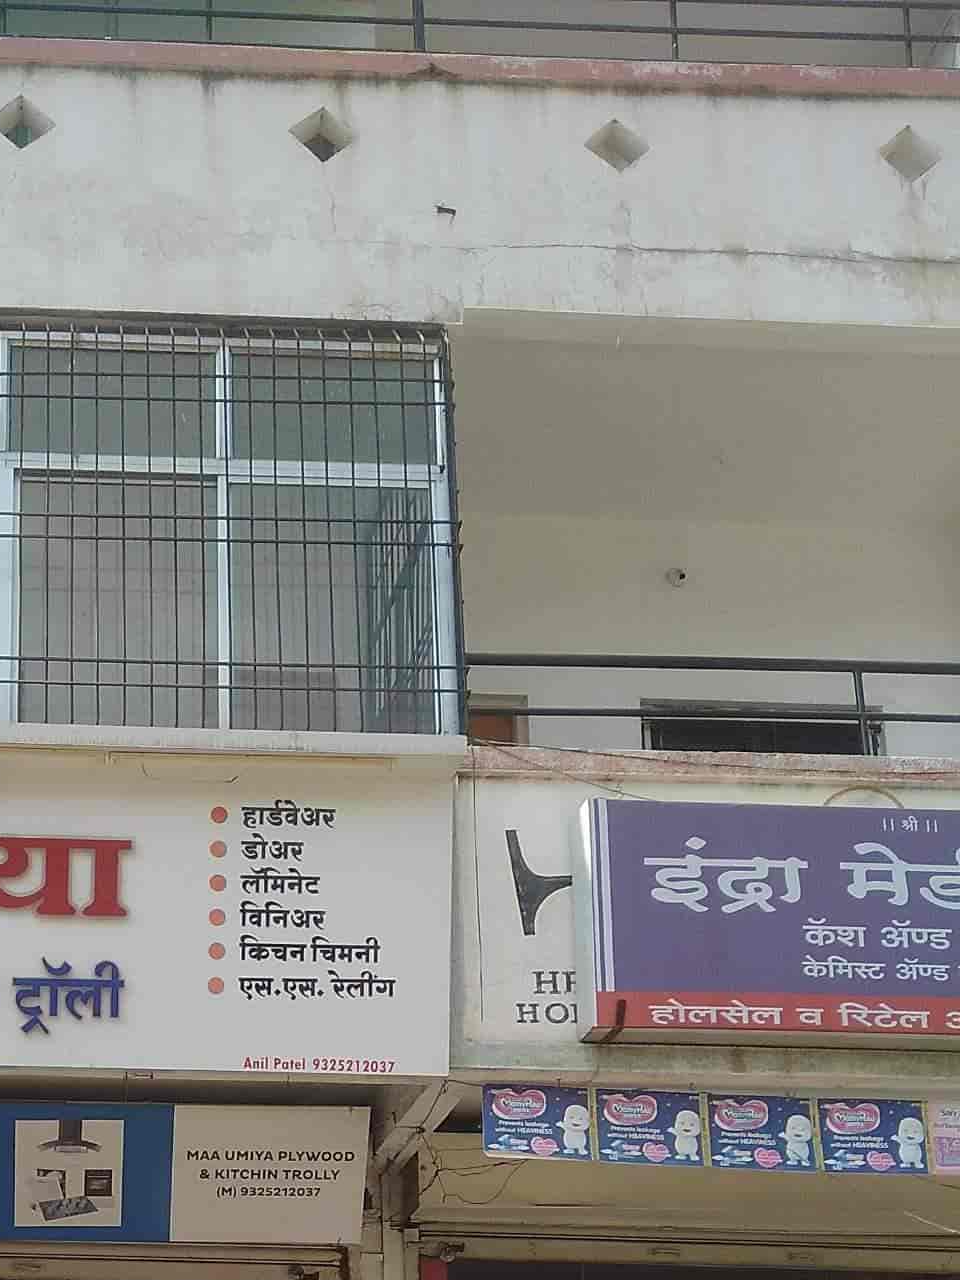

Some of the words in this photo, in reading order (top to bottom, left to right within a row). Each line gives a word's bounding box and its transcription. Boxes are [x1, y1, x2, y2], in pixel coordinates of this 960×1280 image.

[240, 800, 336, 828] हार्डवेअर
[901, 816, 918, 832] श्री
[240, 833, 304, 861] डोअर
[643, 836, 809, 912] इंद्रा
[240, 901, 326, 929] विनिअर
[802, 917, 867, 947] कॅश
[240, 935, 307, 962] किचन
[311, 936, 380, 964] चिमनी
[801, 955, 887, 979] केमिस्ट
[12, 957, 125, 1034] ट्रॉली
[648, 998, 783, 1027] होलसेल
[795, 1008, 825, 1026] व
[837, 1002, 930, 1028] रिटेल
[243, 1057, 269, 1071] Anil
[274, 1058, 306, 1071] Patel
[312, 1058, 395, 1073] 9325212037
[186, 1150, 222, 1162] MAA
[225, 1150, 273, 1163] UMIYA
[278, 1150, 355, 1163] PLYWOOD
[199, 1168, 211, 1180] &
[215, 1168, 279, 1181] KITCHIN
[282, 1169, 341, 1181] TROLLY
[239, 1186, 321, 1199] 9325212037
